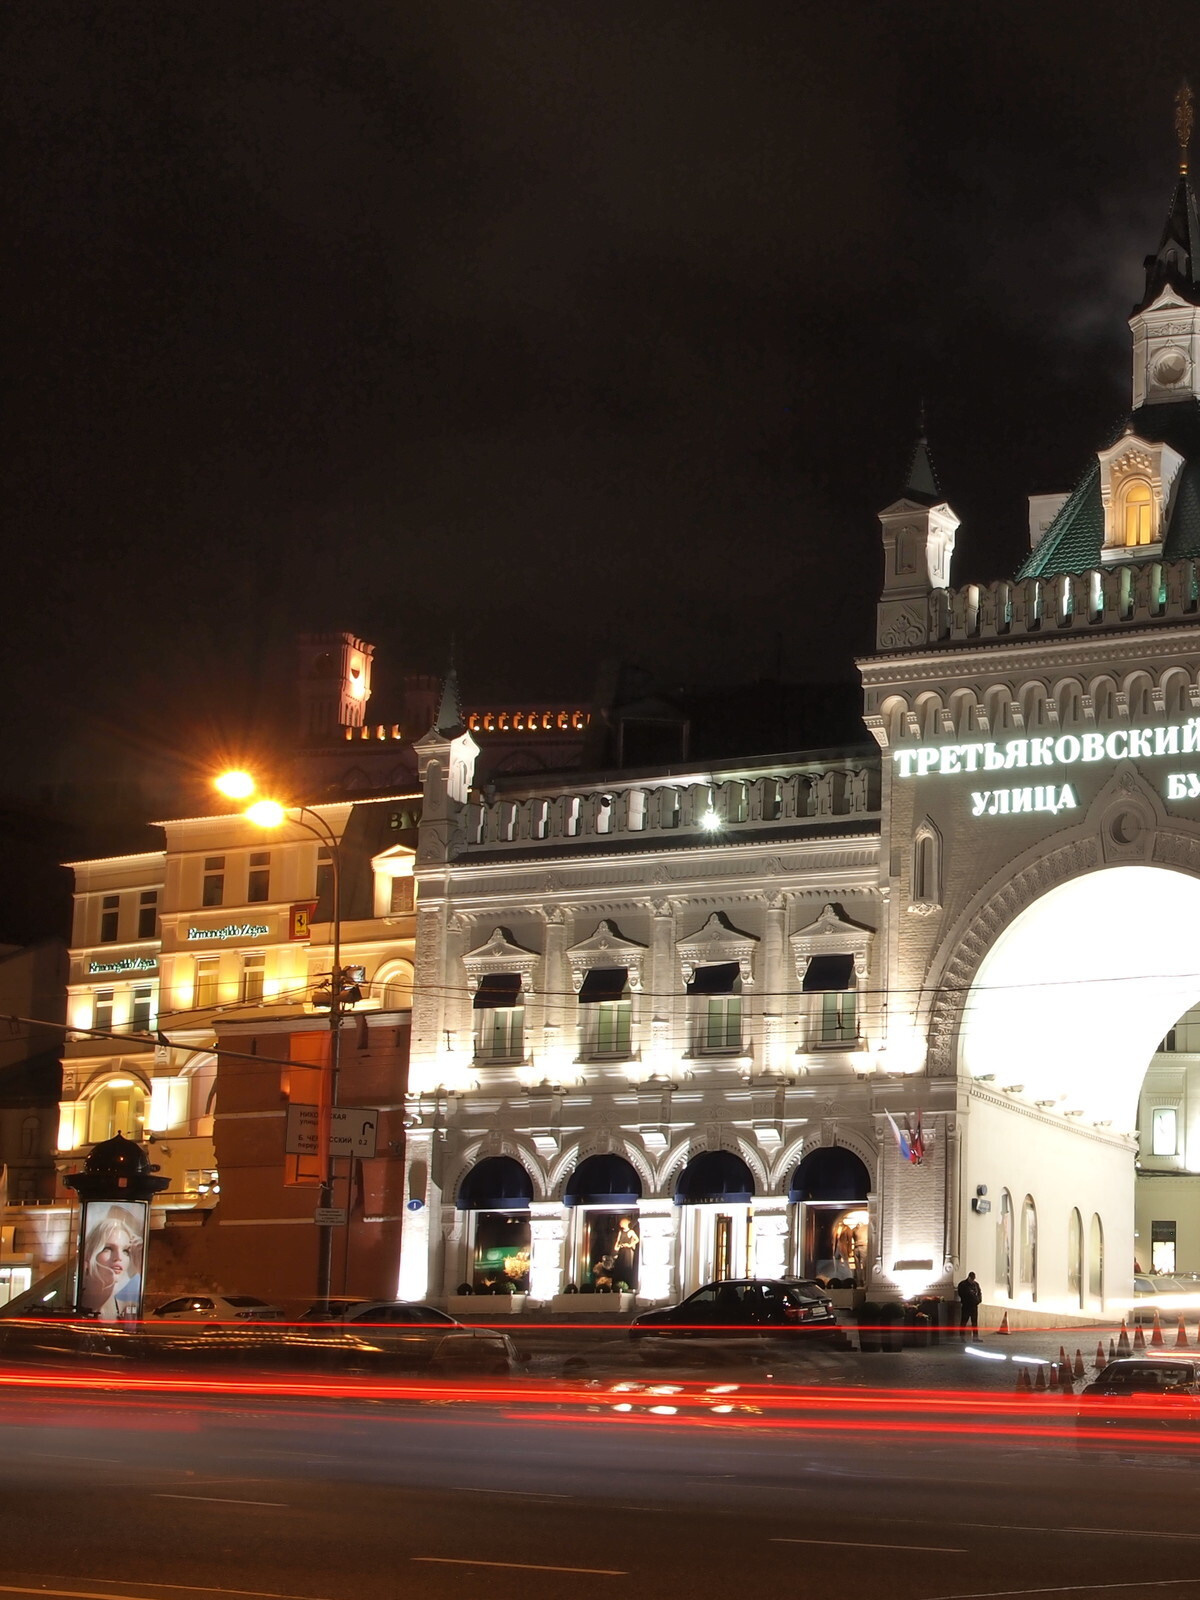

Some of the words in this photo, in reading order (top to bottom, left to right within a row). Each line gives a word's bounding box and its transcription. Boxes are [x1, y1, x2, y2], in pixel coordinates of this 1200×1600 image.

[971, 783, 1077, 816] УЛИЦА
[241, 924, 269, 938] Zegna
[300, 1111, 347, 1120] НИКОКАЯ
